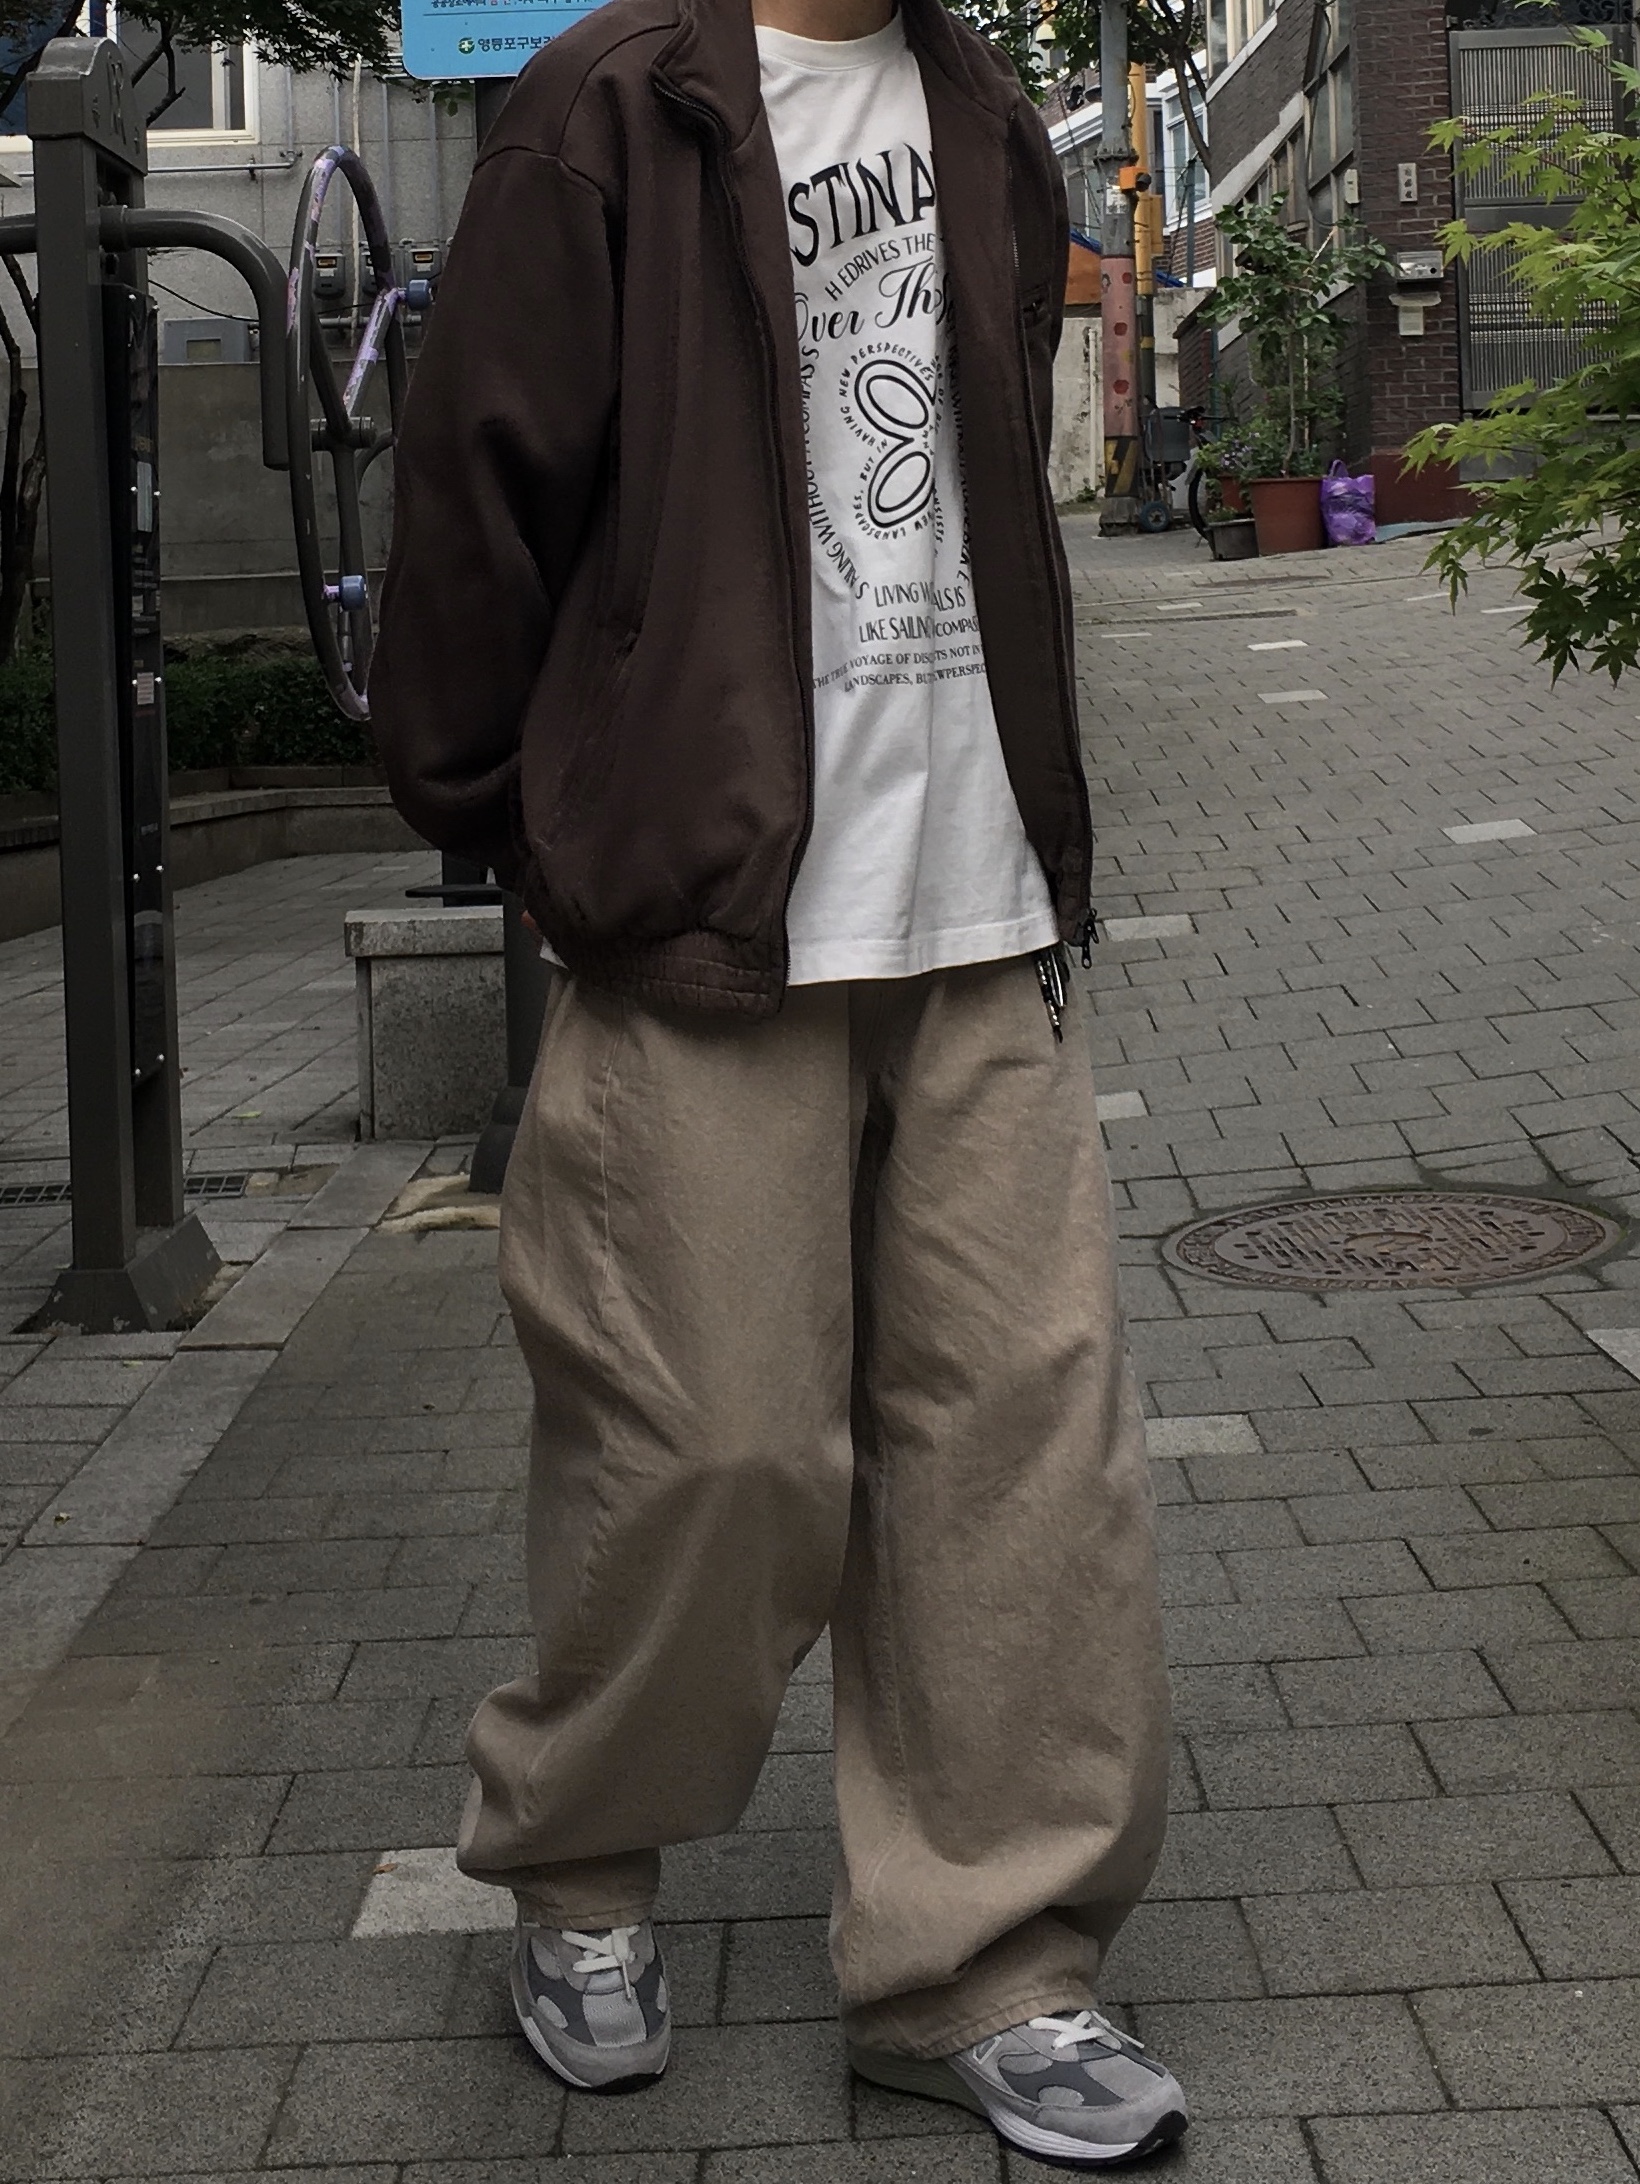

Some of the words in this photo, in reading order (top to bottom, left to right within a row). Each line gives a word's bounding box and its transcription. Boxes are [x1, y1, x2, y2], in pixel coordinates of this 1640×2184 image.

[477, 36, 555, 52] 영등포구보
[788, 142, 936, 267] STINA
[902, 233, 936, 255] THE
[850, 341, 935, 382] PERSPECTIVES
[838, 367, 851, 398] NEW
[840, 405, 877, 447] HAVING
[859, 456, 875, 482] BUT
[876, 438, 888, 453] IN
[954, 585, 966, 608] IS
[859, 618, 888, 643] LIKE
[850, 653, 893, 669] VOYAGE
[895, 653, 911, 665] OF
[949, 645, 970, 659] NOT
